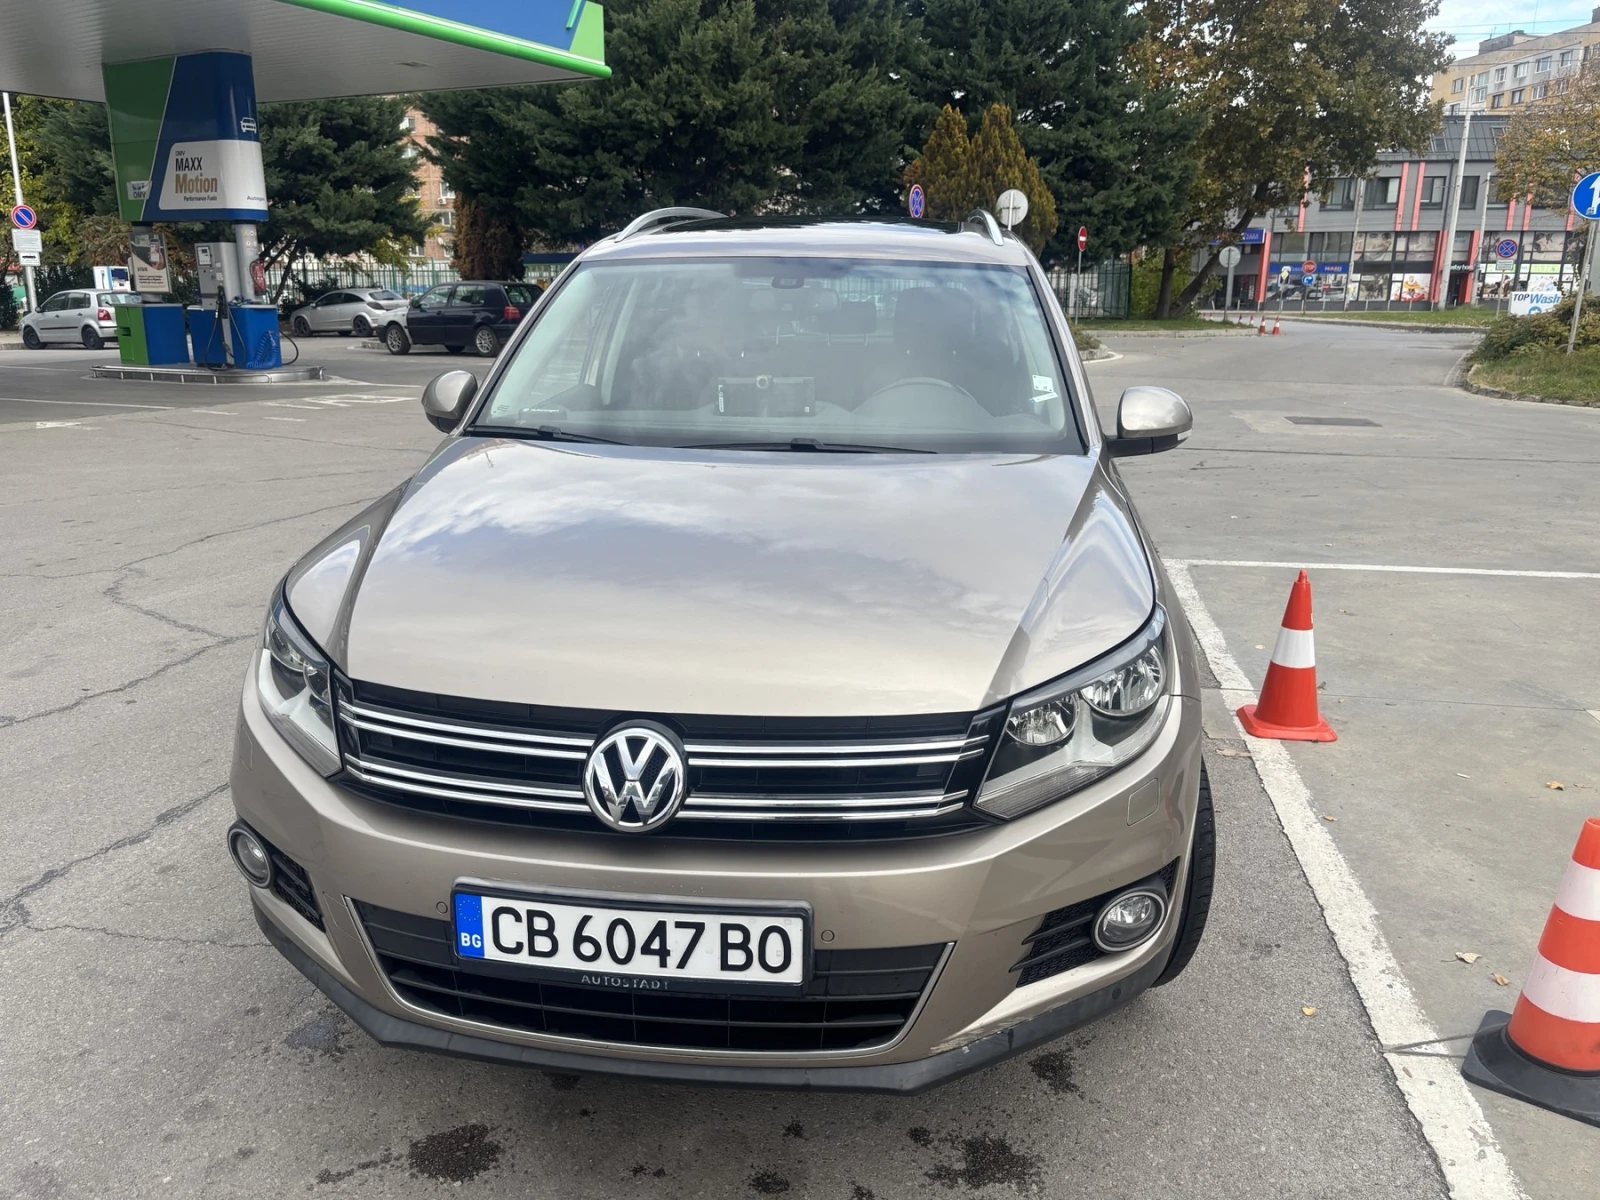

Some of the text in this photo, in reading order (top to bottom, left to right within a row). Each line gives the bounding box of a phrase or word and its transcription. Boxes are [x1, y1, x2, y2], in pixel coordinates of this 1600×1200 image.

[176, 157, 202, 171] MAXX
[175, 172, 217, 194] Motion
[133, 191, 146, 199] OMV
[1513, 293, 1561, 304] TOP Wash
[460, 932, 482, 948] BG
[491, 906, 792, 974] CB 6047 BO
[581, 974, 670, 990] AUTOSTADT
